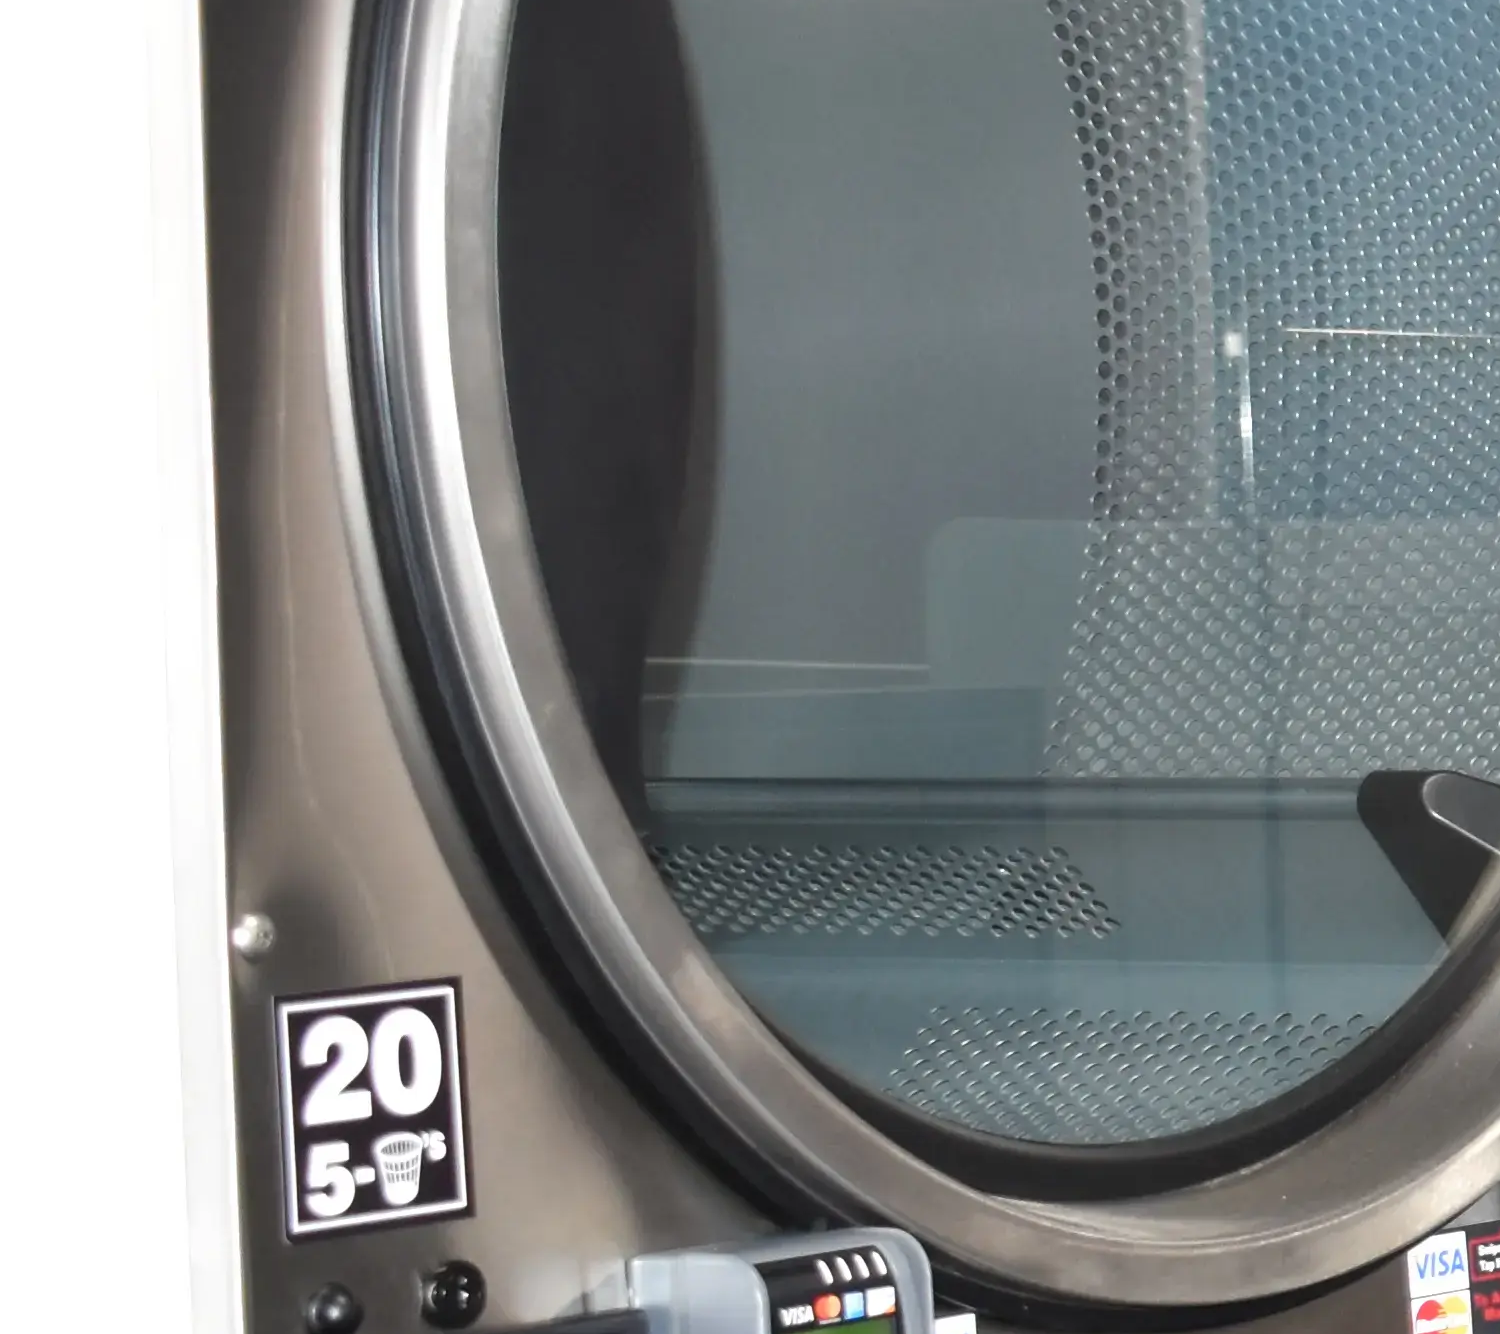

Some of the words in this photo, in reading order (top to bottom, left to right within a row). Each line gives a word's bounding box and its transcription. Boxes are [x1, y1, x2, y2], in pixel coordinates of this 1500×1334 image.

[302, 1007, 442, 1125] 20
[1415, 1248, 1465, 1279] VISA
[780, 1303, 815, 1327] VISA
